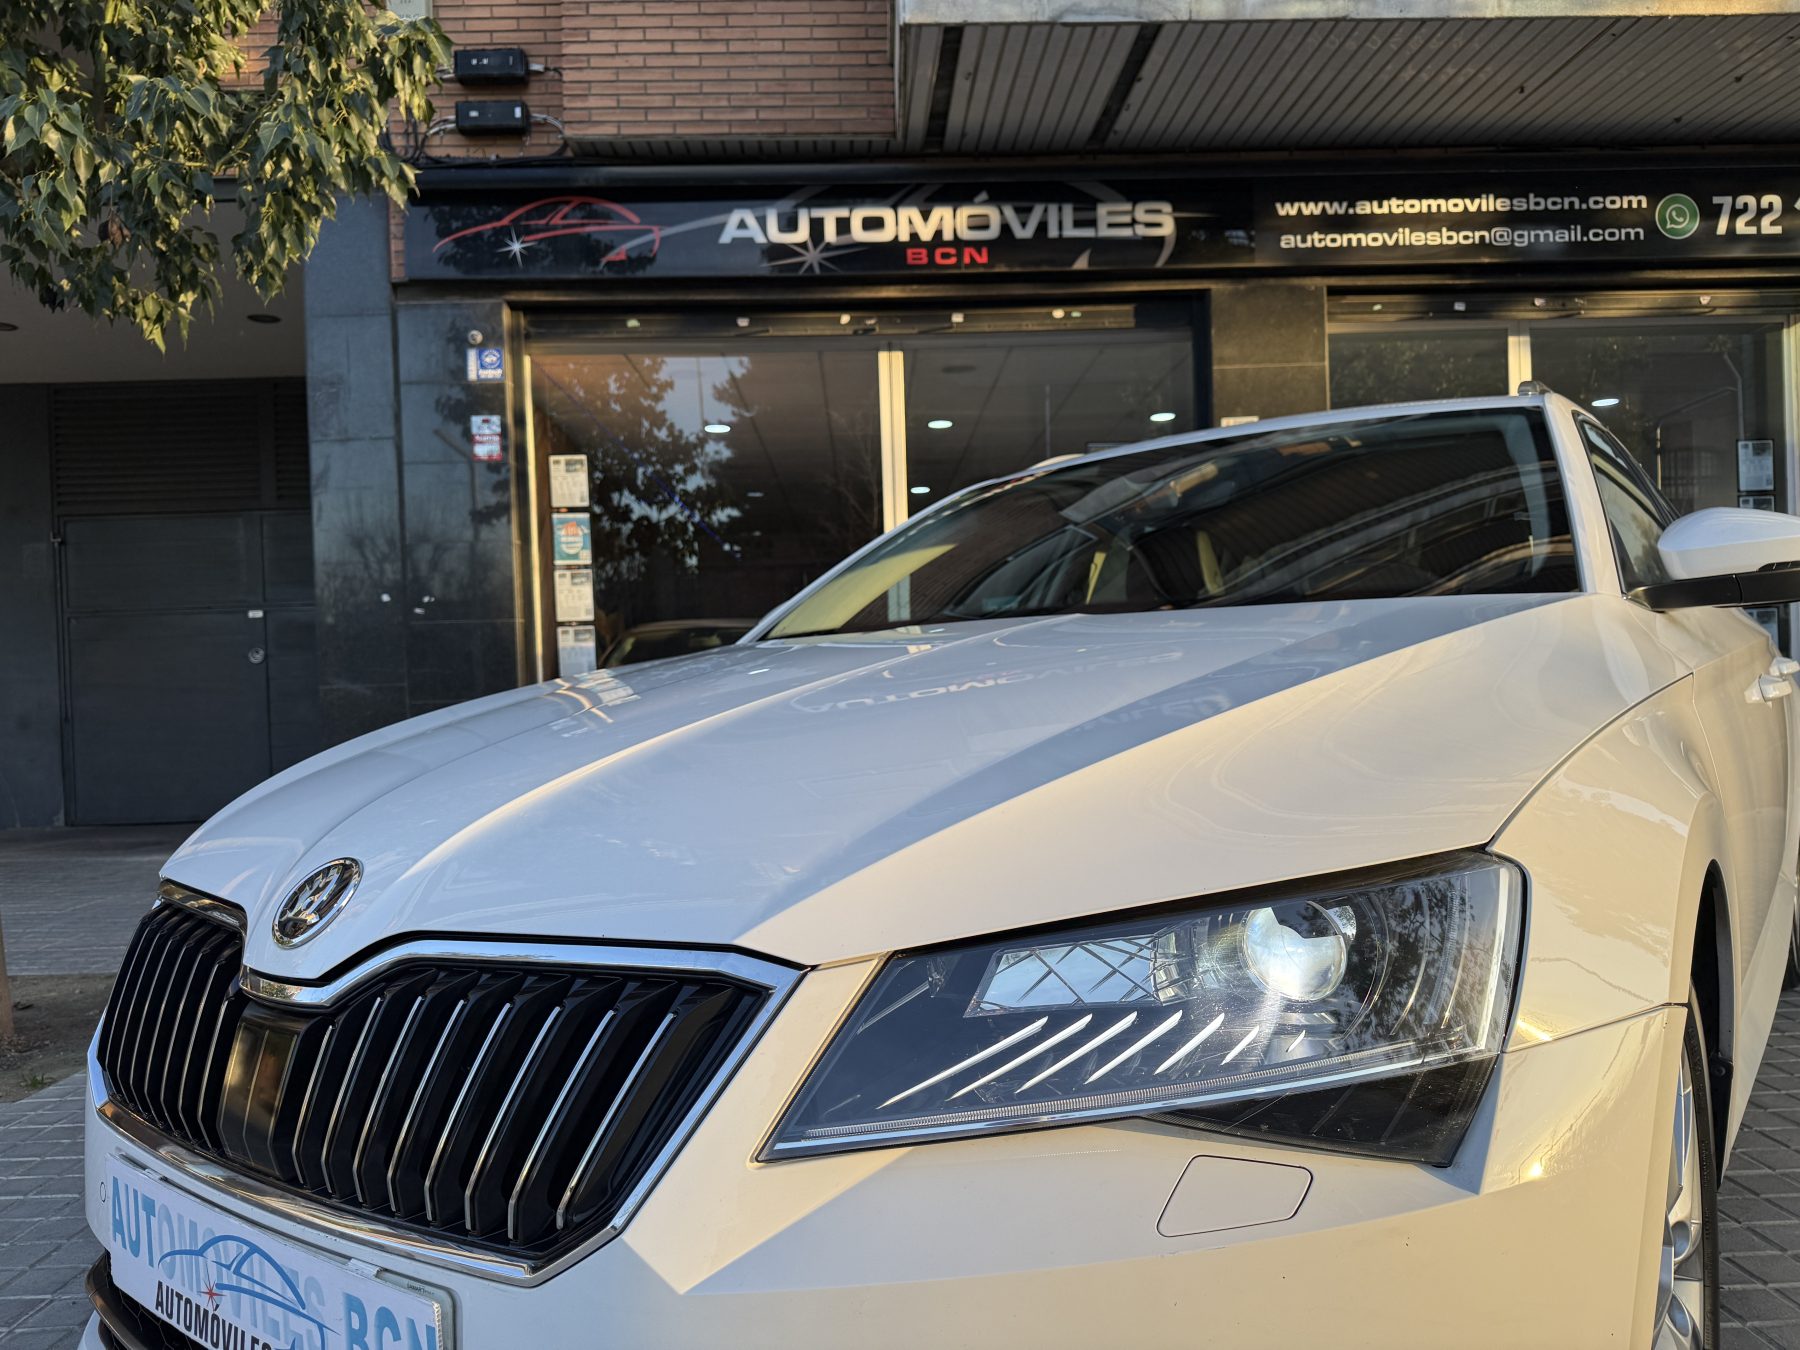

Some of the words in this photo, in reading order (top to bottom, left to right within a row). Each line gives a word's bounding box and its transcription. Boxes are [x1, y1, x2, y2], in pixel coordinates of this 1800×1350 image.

[1275, 194, 1648, 216] www.automovilesbcn.com
[1712, 194, 1783, 235] 722
[718, 190, 1175, 244] AUTOMÓVILES
[1279, 225, 1645, 248] automovilesbcn@gmail.com
[906, 247, 989, 265] BCN
